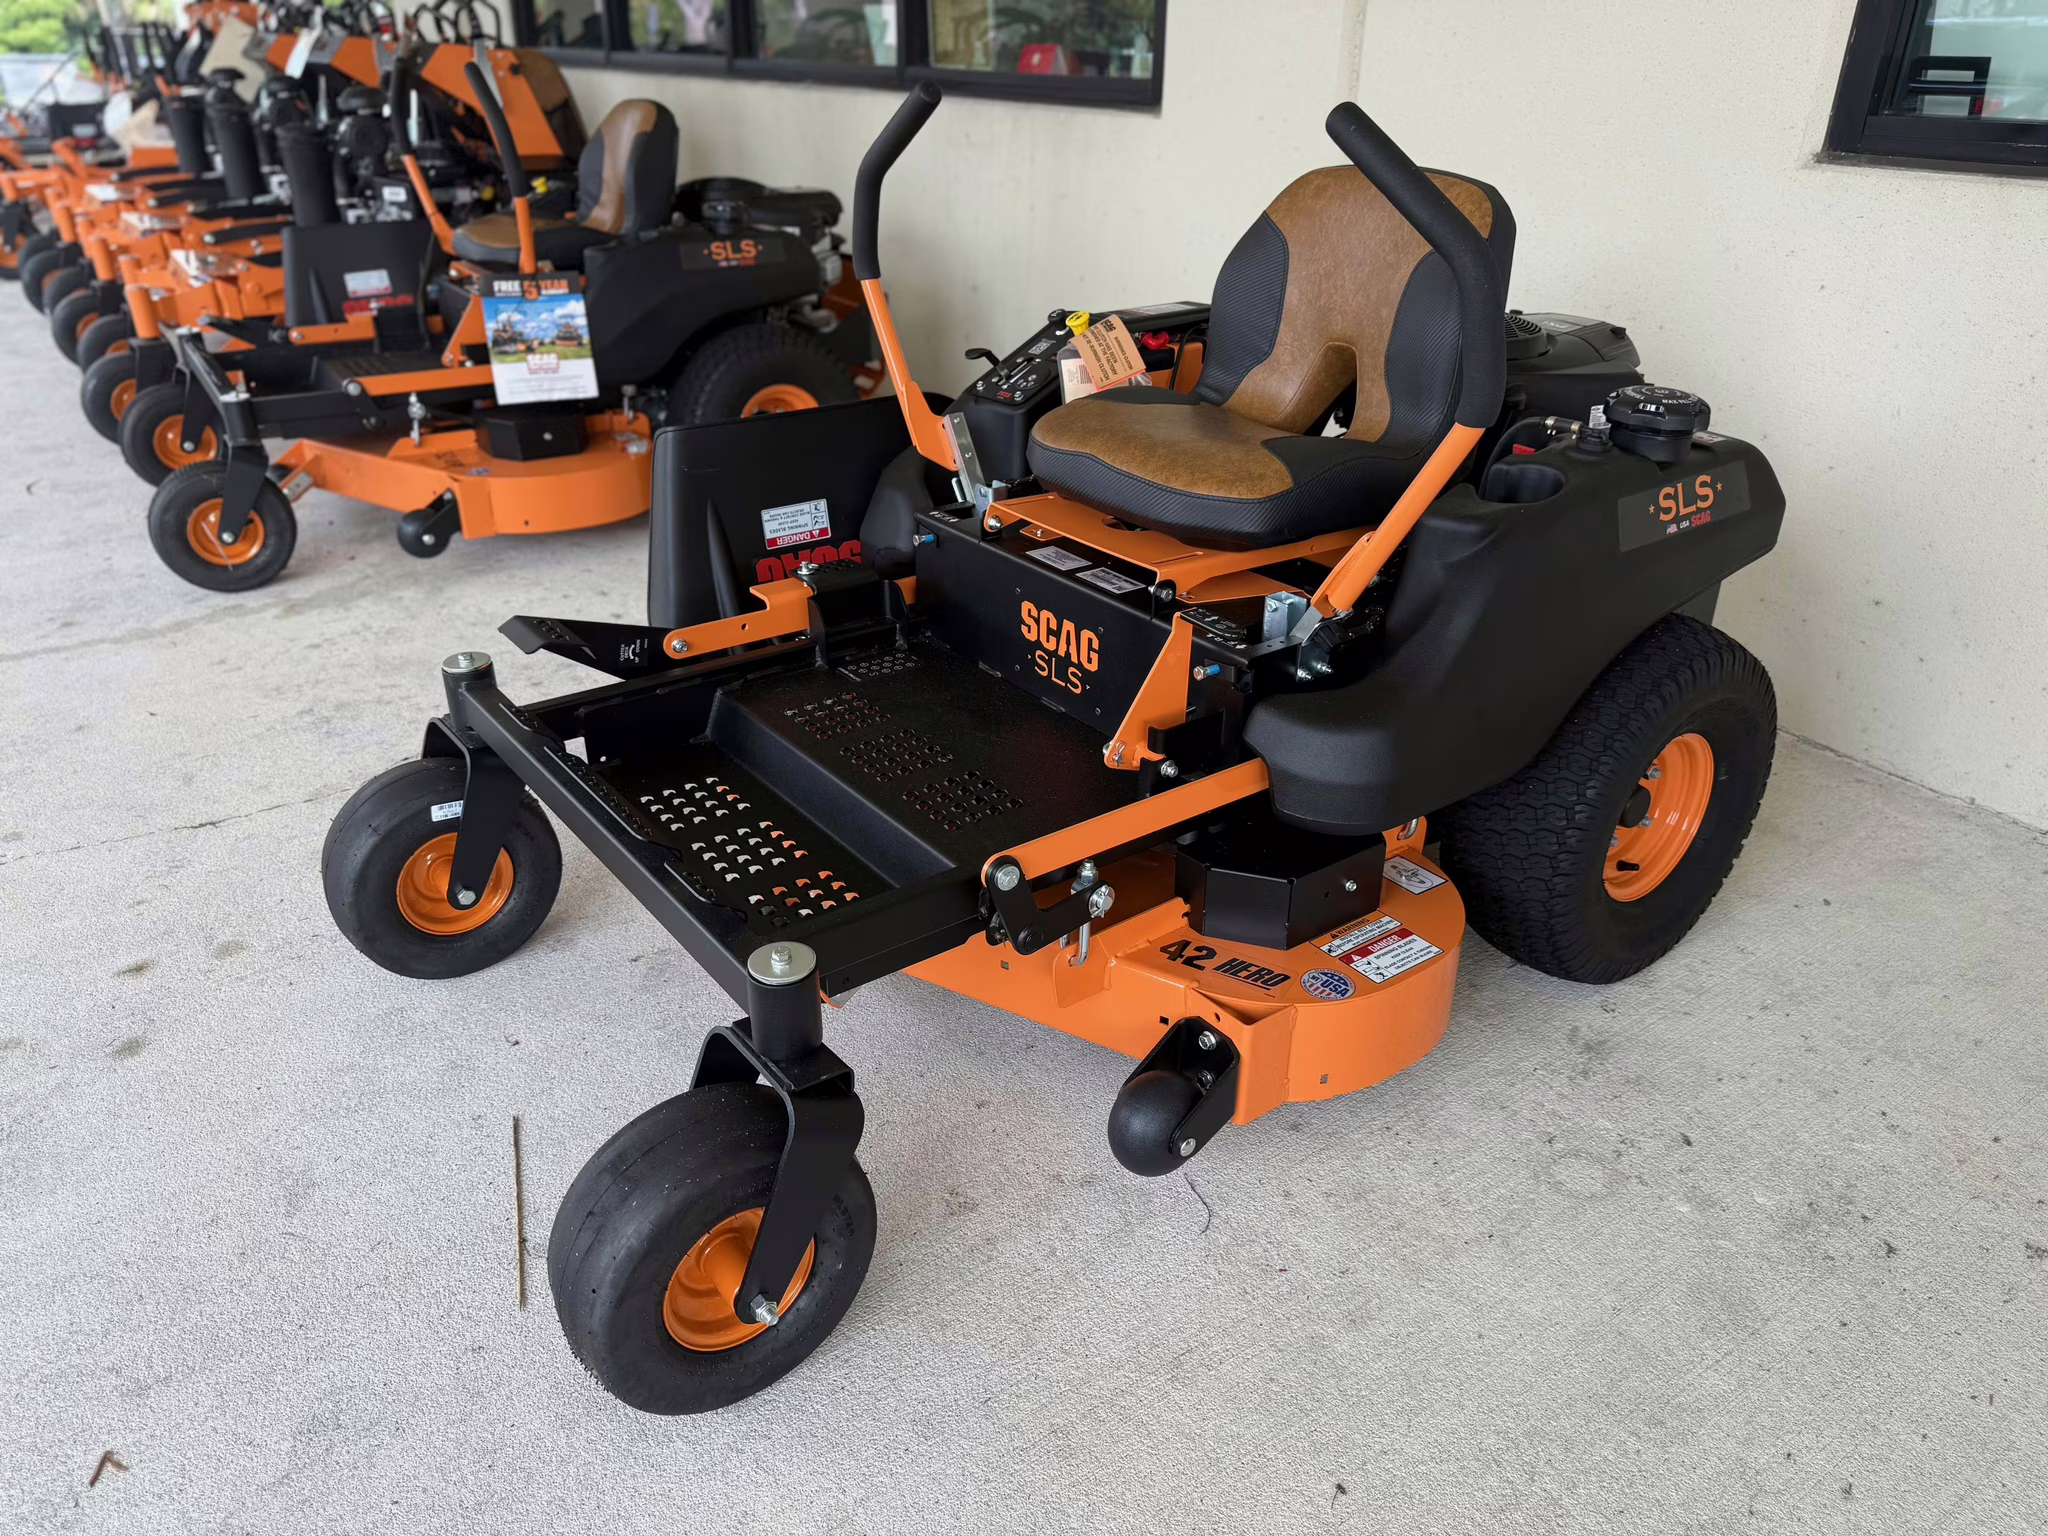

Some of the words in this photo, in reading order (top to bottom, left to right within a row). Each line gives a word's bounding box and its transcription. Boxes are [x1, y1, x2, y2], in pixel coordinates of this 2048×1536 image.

[711, 240, 757, 261] SLS
[493, 280, 520, 292] FREE
[1105, 355, 1118, 376] FACTORY
[1109, 351, 1119, 364] BEEN
[1123, 354, 1133, 370] CLUTCH
[1098, 361, 1110, 381] CLUTCH
[1658, 475, 1715, 522] SLS
[787, 523, 809, 531] SPINNING
[1680, 520, 1690, 529] USA
[1690, 510, 1712, 528] SCAG
[769, 526, 787, 534] BLADES
[776, 532, 811, 545] DANGER
[1021, 600, 1100, 673] SCAG
[1034, 649, 1083, 695] SLS
[1337, 917, 1370, 936] WARNING
[1367, 934, 1402, 953] DANGER
[1373, 946, 1398, 960] SPINNING
[1397, 938, 1417, 949] BLADES
[1160, 939, 1217, 971] 42
[1212, 957, 1291, 988] HERO
[1320, 979, 1350, 998] USA
